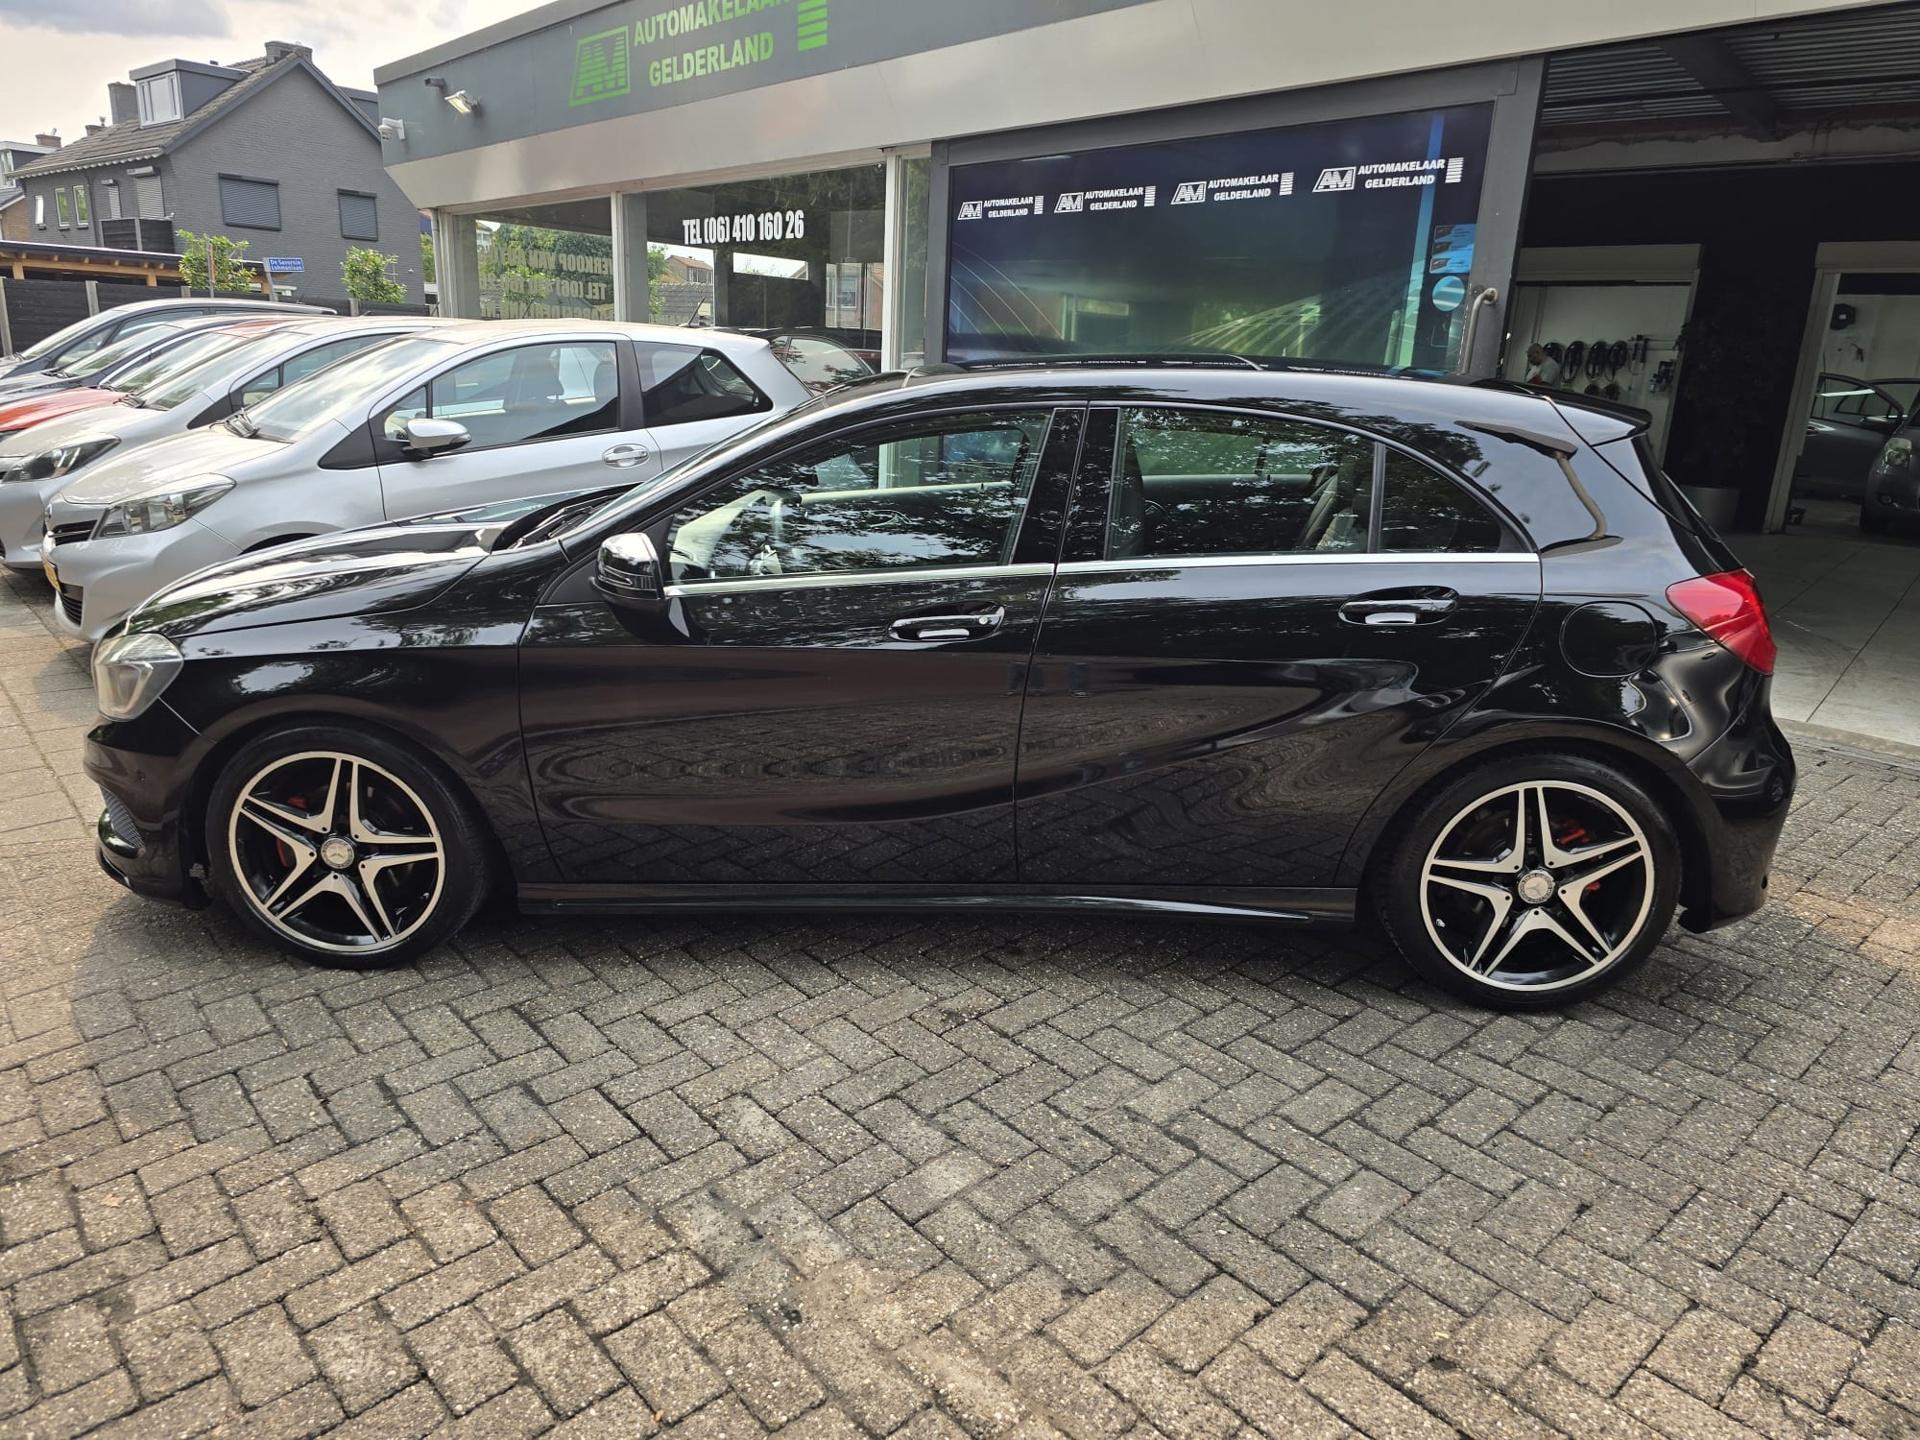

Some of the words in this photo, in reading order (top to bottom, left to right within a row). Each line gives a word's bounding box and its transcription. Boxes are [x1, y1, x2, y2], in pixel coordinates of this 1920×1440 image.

[634, 0, 789, 47] AUTOMAKEL
[649, 31, 774, 87] GELDERLAND
[1358, 159, 1446, 175] AUTOMAKELAAR
[1207, 174, 1279, 189] AUTOMAKELAAR
[1364, 175, 1436, 189] GELDERLAND
[1084, 187, 1144, 199] AUTOMAKELAAR
[1213, 188, 1271, 201] GELDERLAND
[983, 196, 1034, 207] AUTOMAKELAAR
[1089, 200, 1138, 211] GELDERLAND
[988, 208, 1029, 218] GELDERLAND
[682, 218, 702, 245] TEL
[704, 216, 730, 244] (06)
[732, 213, 756, 242] 410
[757, 211, 783, 240] 160
[785, 209, 805, 239] 26
